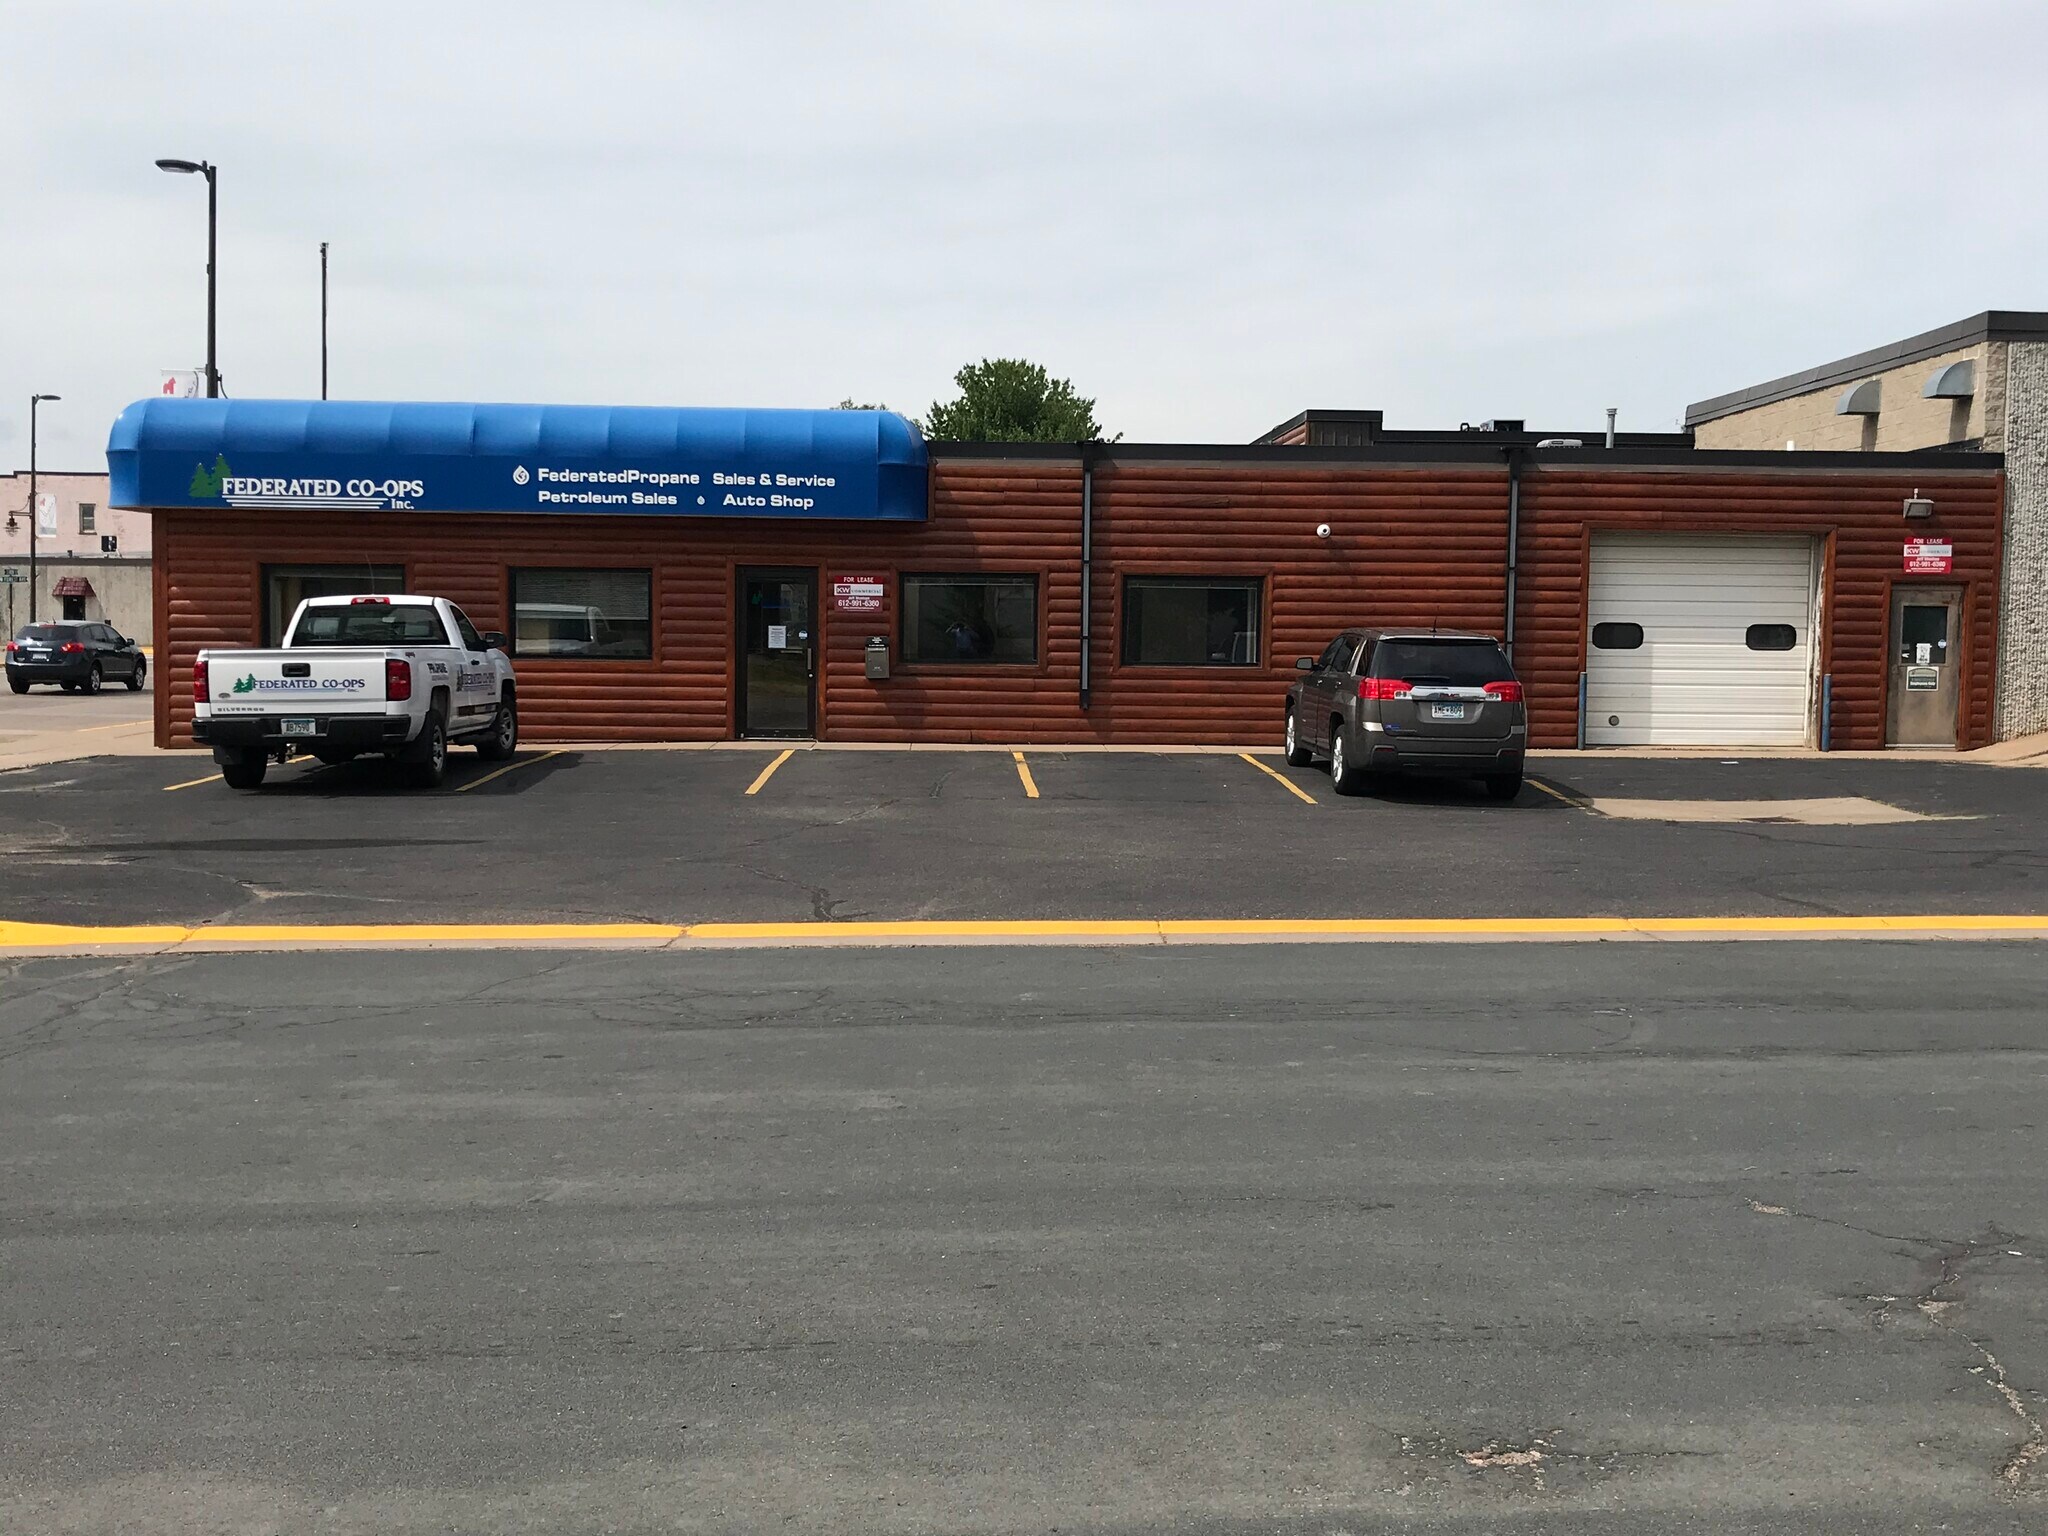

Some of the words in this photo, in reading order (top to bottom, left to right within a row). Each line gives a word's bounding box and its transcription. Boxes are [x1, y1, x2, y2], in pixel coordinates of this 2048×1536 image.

[537, 468, 700, 487] FederatedPropane
[713, 473, 756, 486] Sales
[759, 473, 772, 486] &
[775, 474, 836, 487] Service
[221, 477, 341, 497] FEDERATED
[346, 479, 424, 498] CO-OPS
[391, 498, 415, 510] Inc.
[538, 490, 627, 504] Petroleum
[632, 491, 677, 505] Sales
[723, 493, 766, 508] Auto
[770, 494, 814, 510] Shop
[836, 586, 851, 594] KW
[253, 679, 317, 689] FEDERATED
[322, 679, 365, 689] CO-OPS
